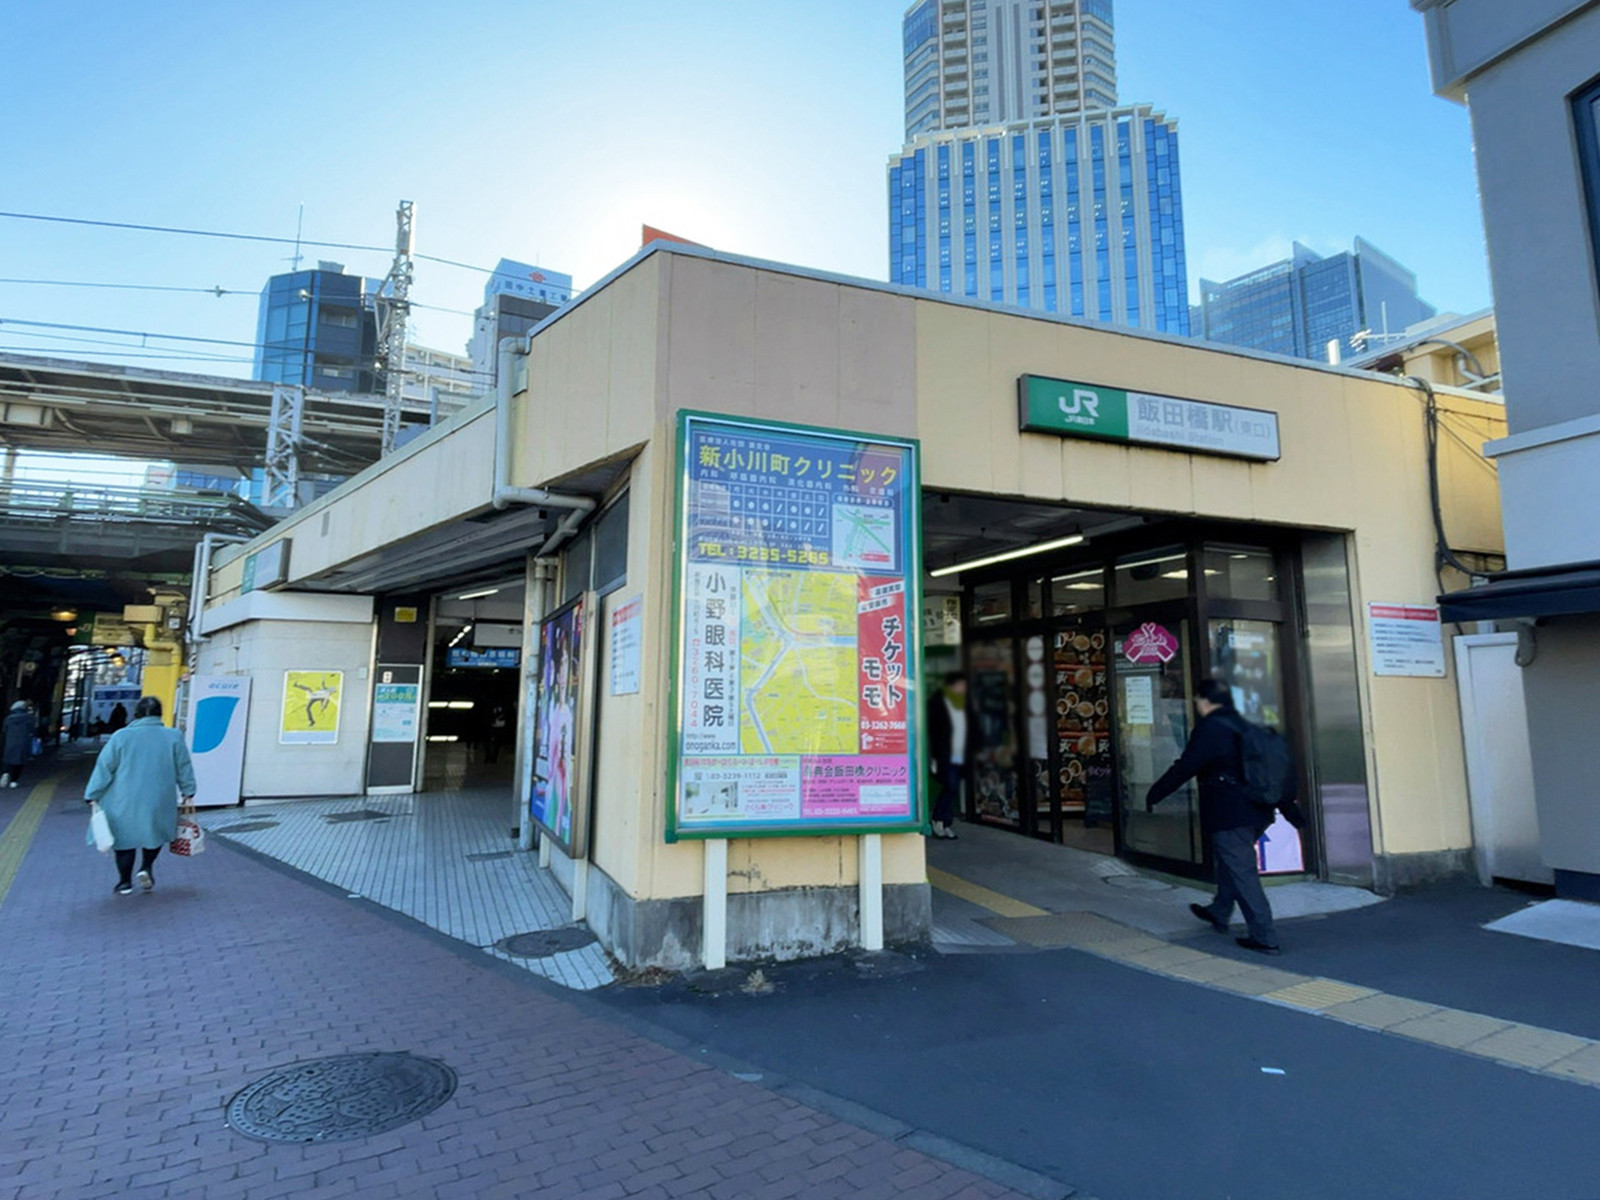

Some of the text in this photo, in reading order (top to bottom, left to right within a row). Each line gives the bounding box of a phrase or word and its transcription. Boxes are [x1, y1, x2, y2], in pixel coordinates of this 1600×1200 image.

[1058, 388, 1100, 418] JR
[699, 444, 897, 486] 新小川町クリニック
[703, 571, 726, 728] 小野眼科医院
[883, 616, 902, 706] チケット
[863, 659, 881, 706] モモ
[686, 740, 737, 752] onoganka.com
